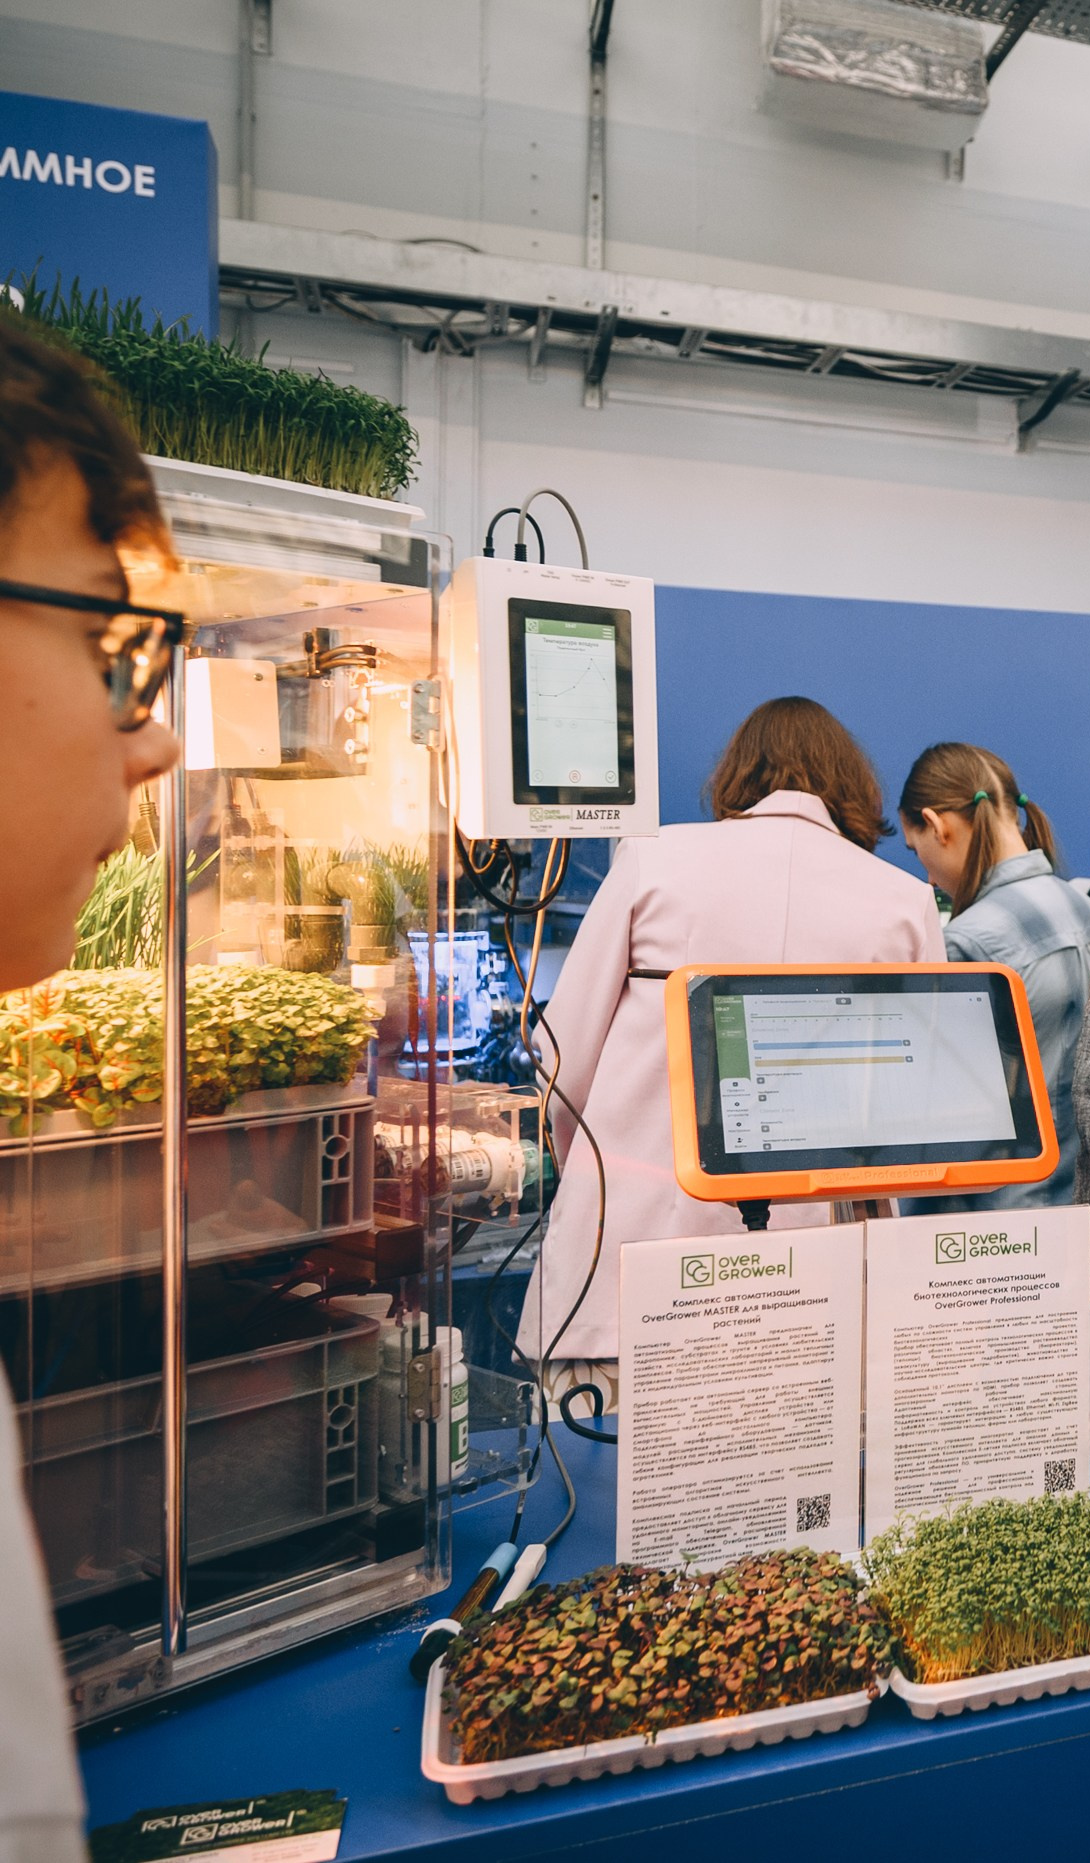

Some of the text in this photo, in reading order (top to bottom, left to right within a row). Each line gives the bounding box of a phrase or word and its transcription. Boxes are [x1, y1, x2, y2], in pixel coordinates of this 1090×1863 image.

[576, 809, 620, 820] MASTER
[929, 1271, 1046, 1289] Комплекс автоматизации
[672, 1288, 801, 1308] Комплекс автоматизации
[913, 1281, 1060, 1301] биотехнологических процессов
[641, 1297, 829, 1324] OverGrower MASTER для выращивания
[934, 1293, 1041, 1310] OverGrower Professional
[713, 1315, 761, 1330] растений
